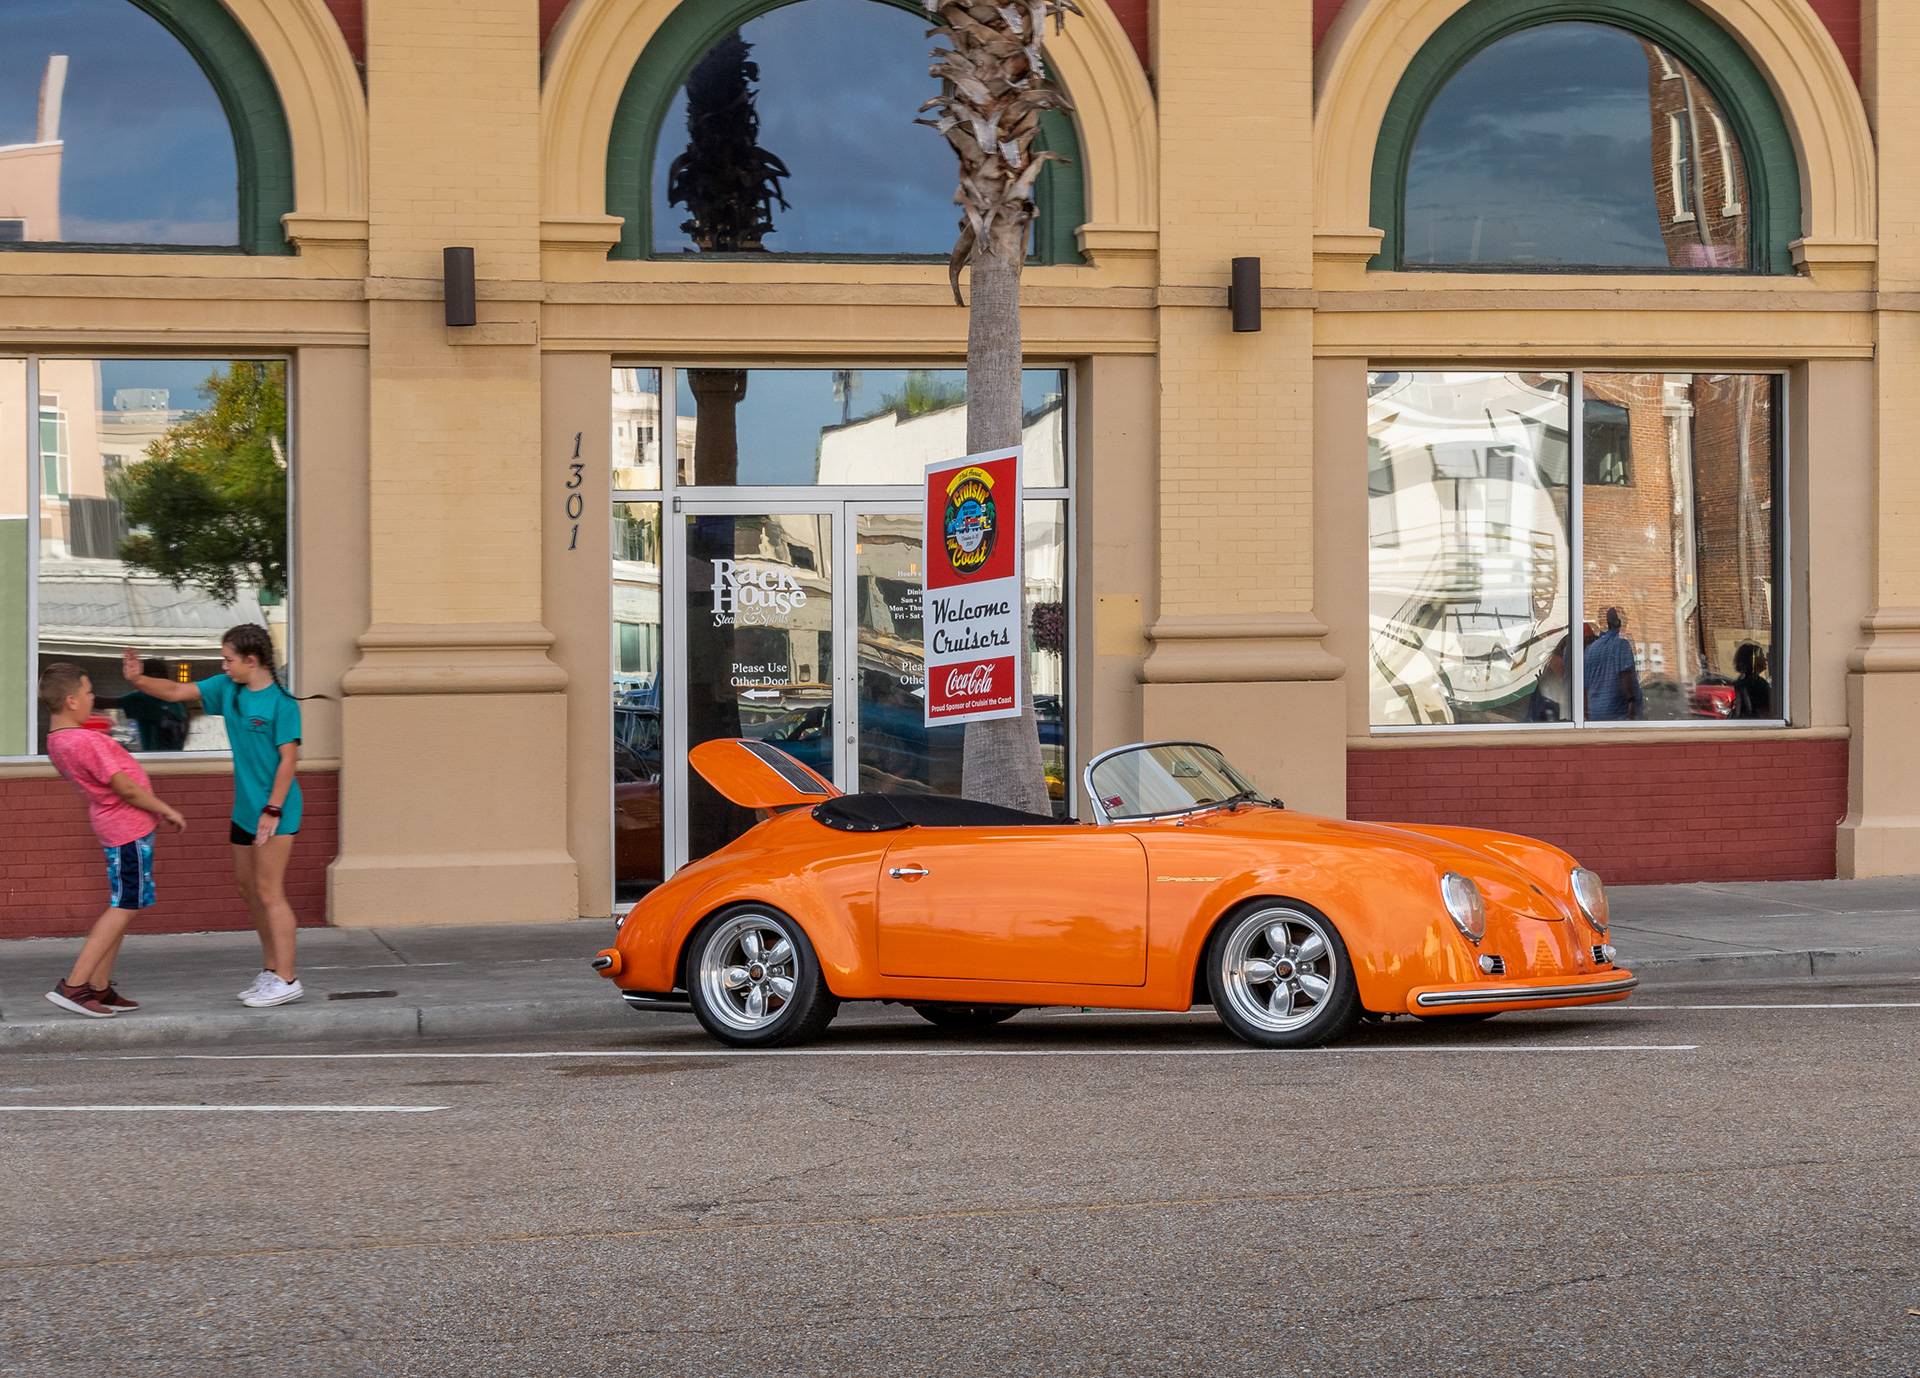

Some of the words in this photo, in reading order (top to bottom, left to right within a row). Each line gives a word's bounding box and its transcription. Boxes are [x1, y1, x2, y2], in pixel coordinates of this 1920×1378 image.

[565, 431, 585, 551] 1301
[946, 538, 958, 550] The
[952, 540, 986, 566] Coast
[932, 598, 1010, 625] Welcome
[932, 626, 1010, 654] Cruisers
[732, 662, 764, 673] Please
[768, 662, 788, 672] Use
[902, 661, 925, 671] Plea
[730, 676, 760, 686] Other
[763, 676, 789, 686] Door
[900, 674, 924, 685] Othe
[931, 704, 945, 712] Proud
[946, 702, 965, 712] Sponsor
